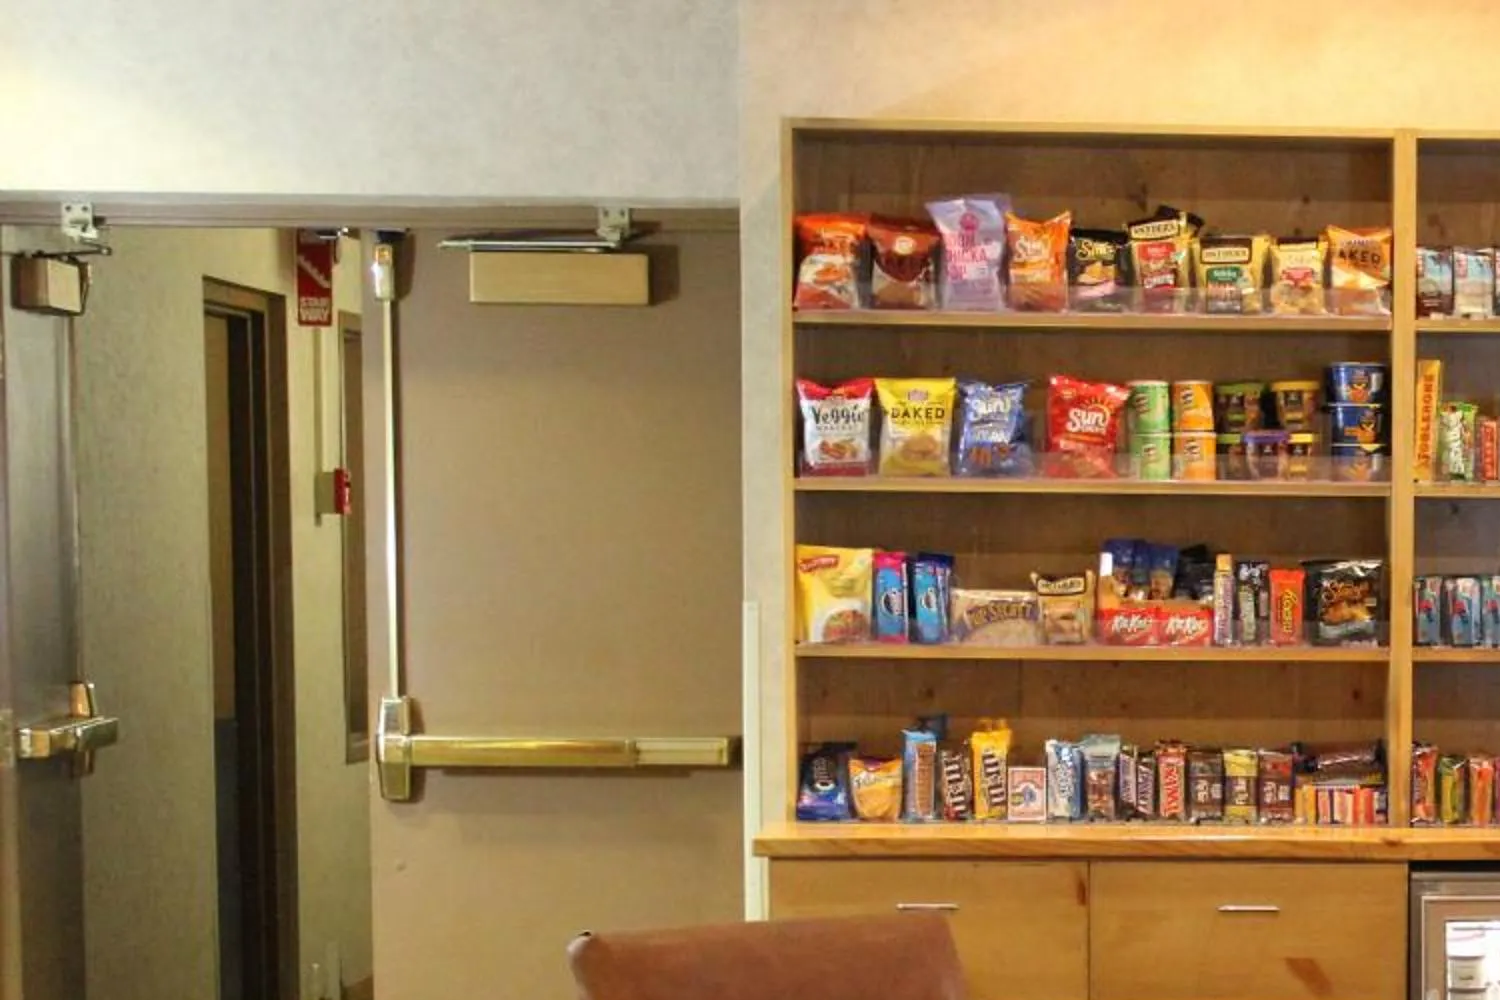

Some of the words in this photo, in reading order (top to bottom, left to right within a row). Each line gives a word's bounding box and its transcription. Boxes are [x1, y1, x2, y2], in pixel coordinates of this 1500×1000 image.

[300, 307, 330, 321] WAY
[811, 403, 865, 426] Veggie
[890, 407, 946, 420] BAKED
[1066, 408, 1106, 432] Sun
